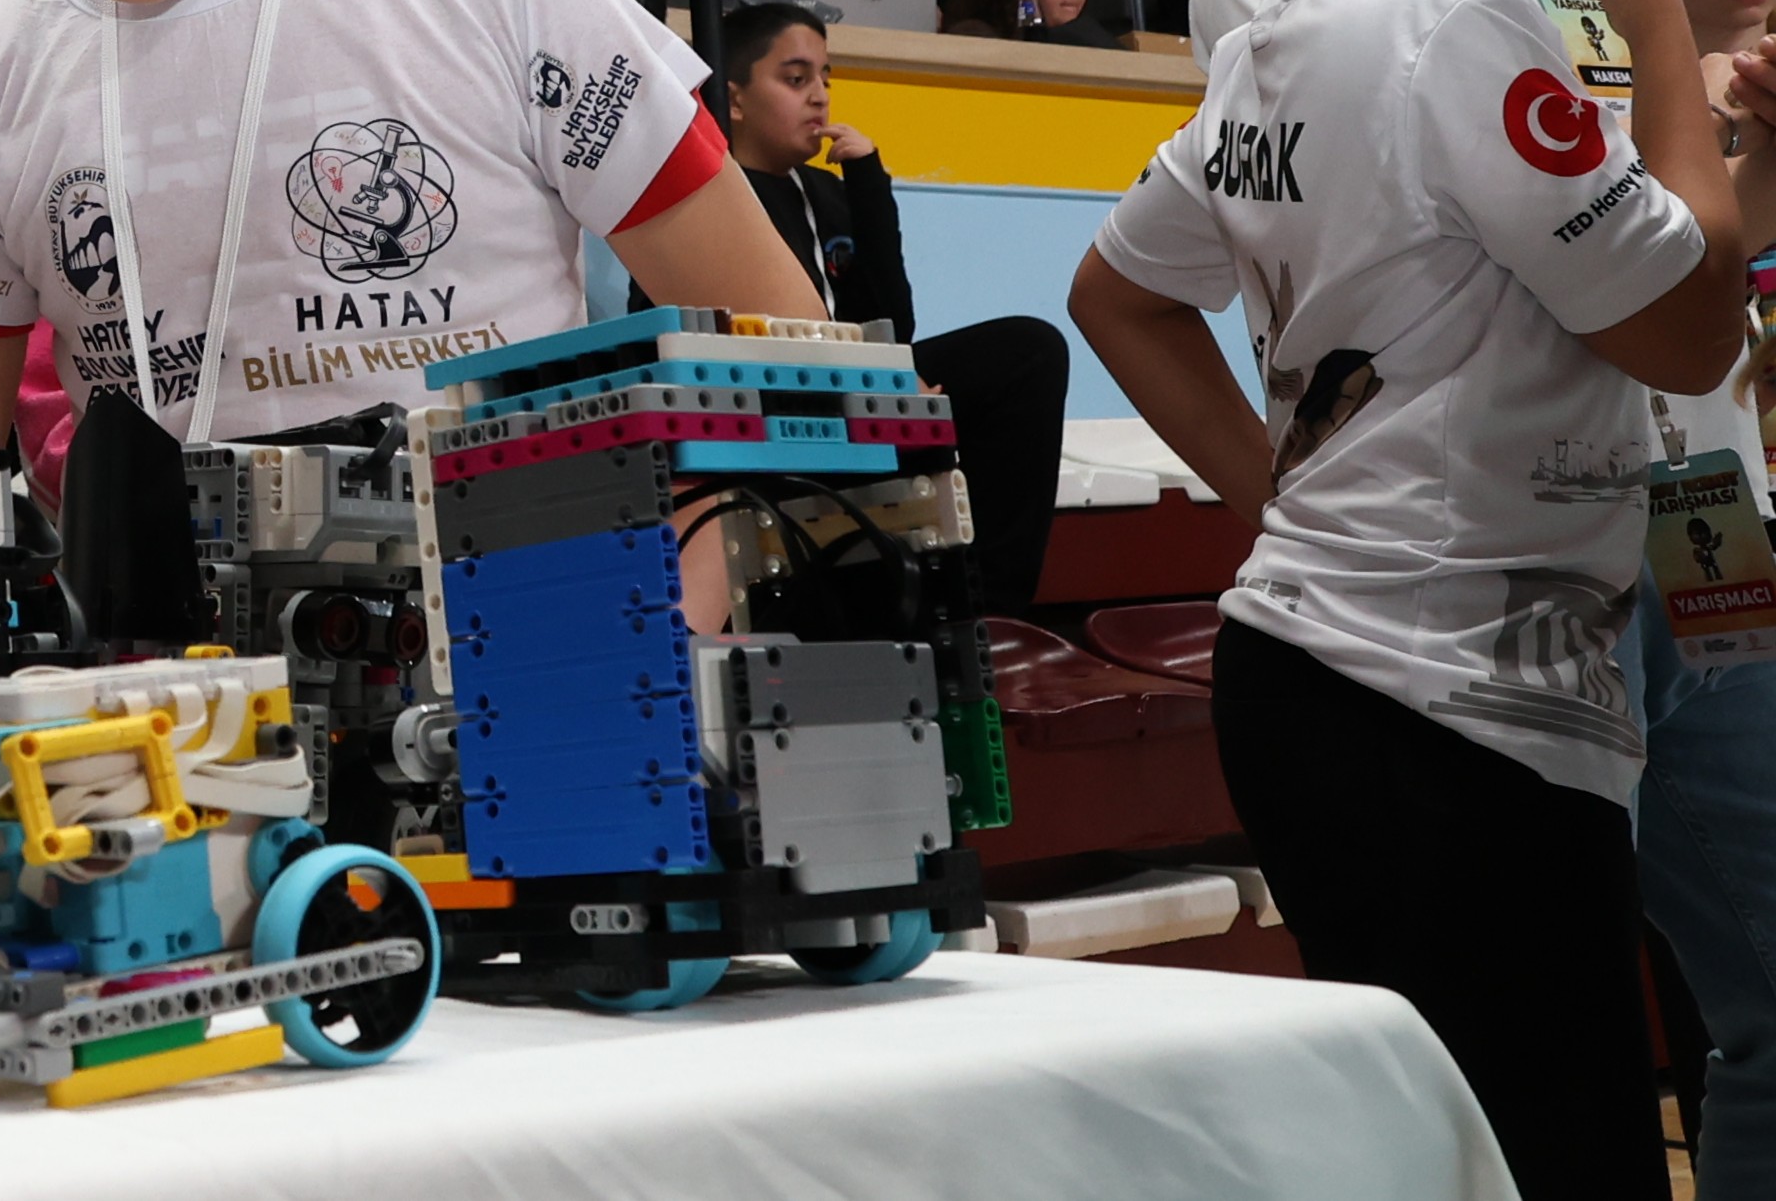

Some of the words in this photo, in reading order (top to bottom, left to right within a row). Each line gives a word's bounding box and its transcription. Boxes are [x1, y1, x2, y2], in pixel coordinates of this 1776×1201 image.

[1591, 70, 1632, 84] HAKEM
[561, 73, 599, 138] HATAY
[1553, 212, 1594, 244] TED
[1590, 173, 1642, 218] Hatay
[295, 285, 456, 332] HATAY
[242, 342, 354, 392] BİLİM
[1674, 586, 1772, 614] YARIŞMACI
